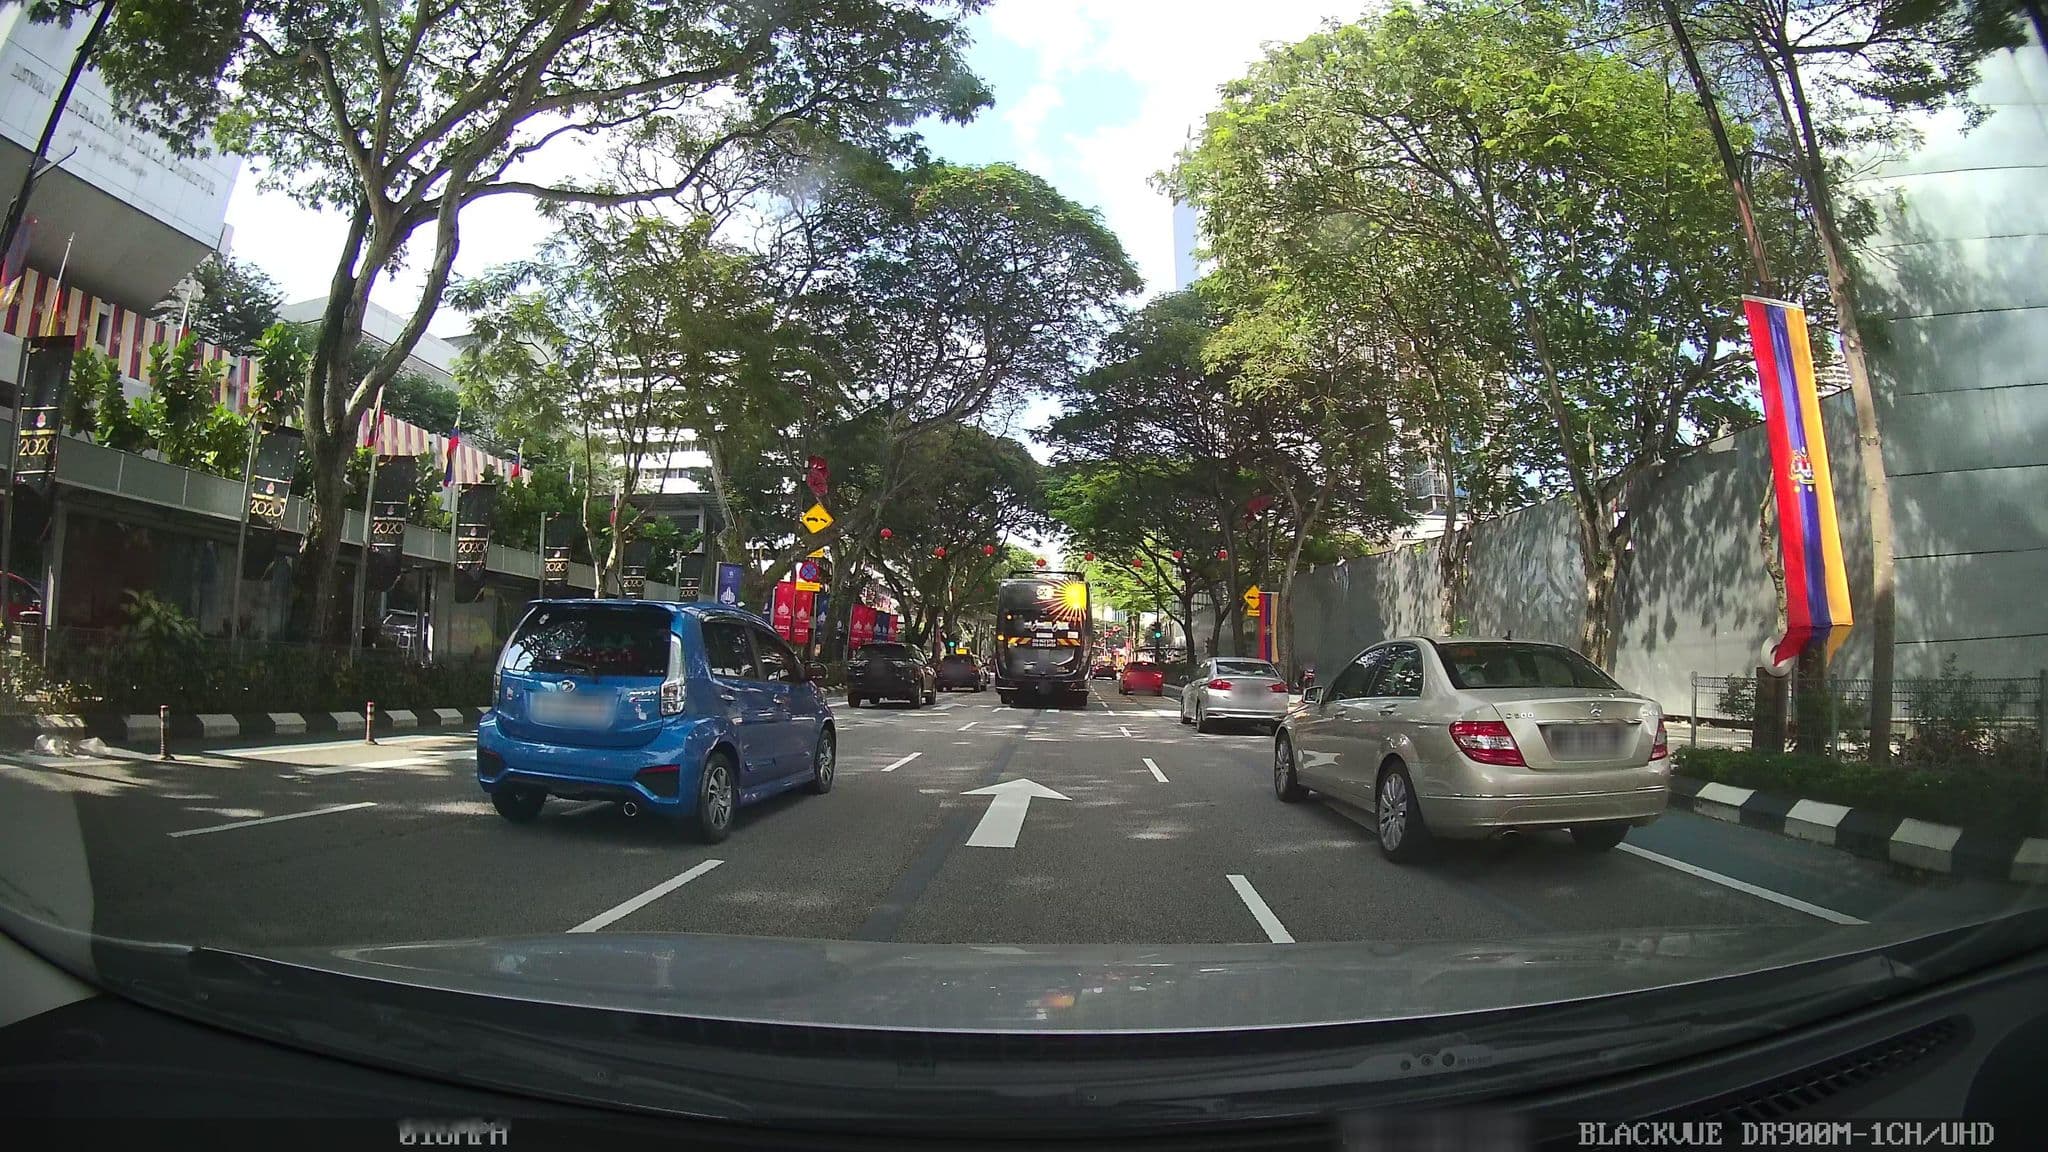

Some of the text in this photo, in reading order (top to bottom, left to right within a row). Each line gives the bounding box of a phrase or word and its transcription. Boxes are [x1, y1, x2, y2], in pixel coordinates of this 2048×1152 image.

[250, 499, 283, 517] 2020
[373, 521, 404, 534] 2020
[458, 541, 486, 553] 2020
[544, 561, 568, 572] 2020
